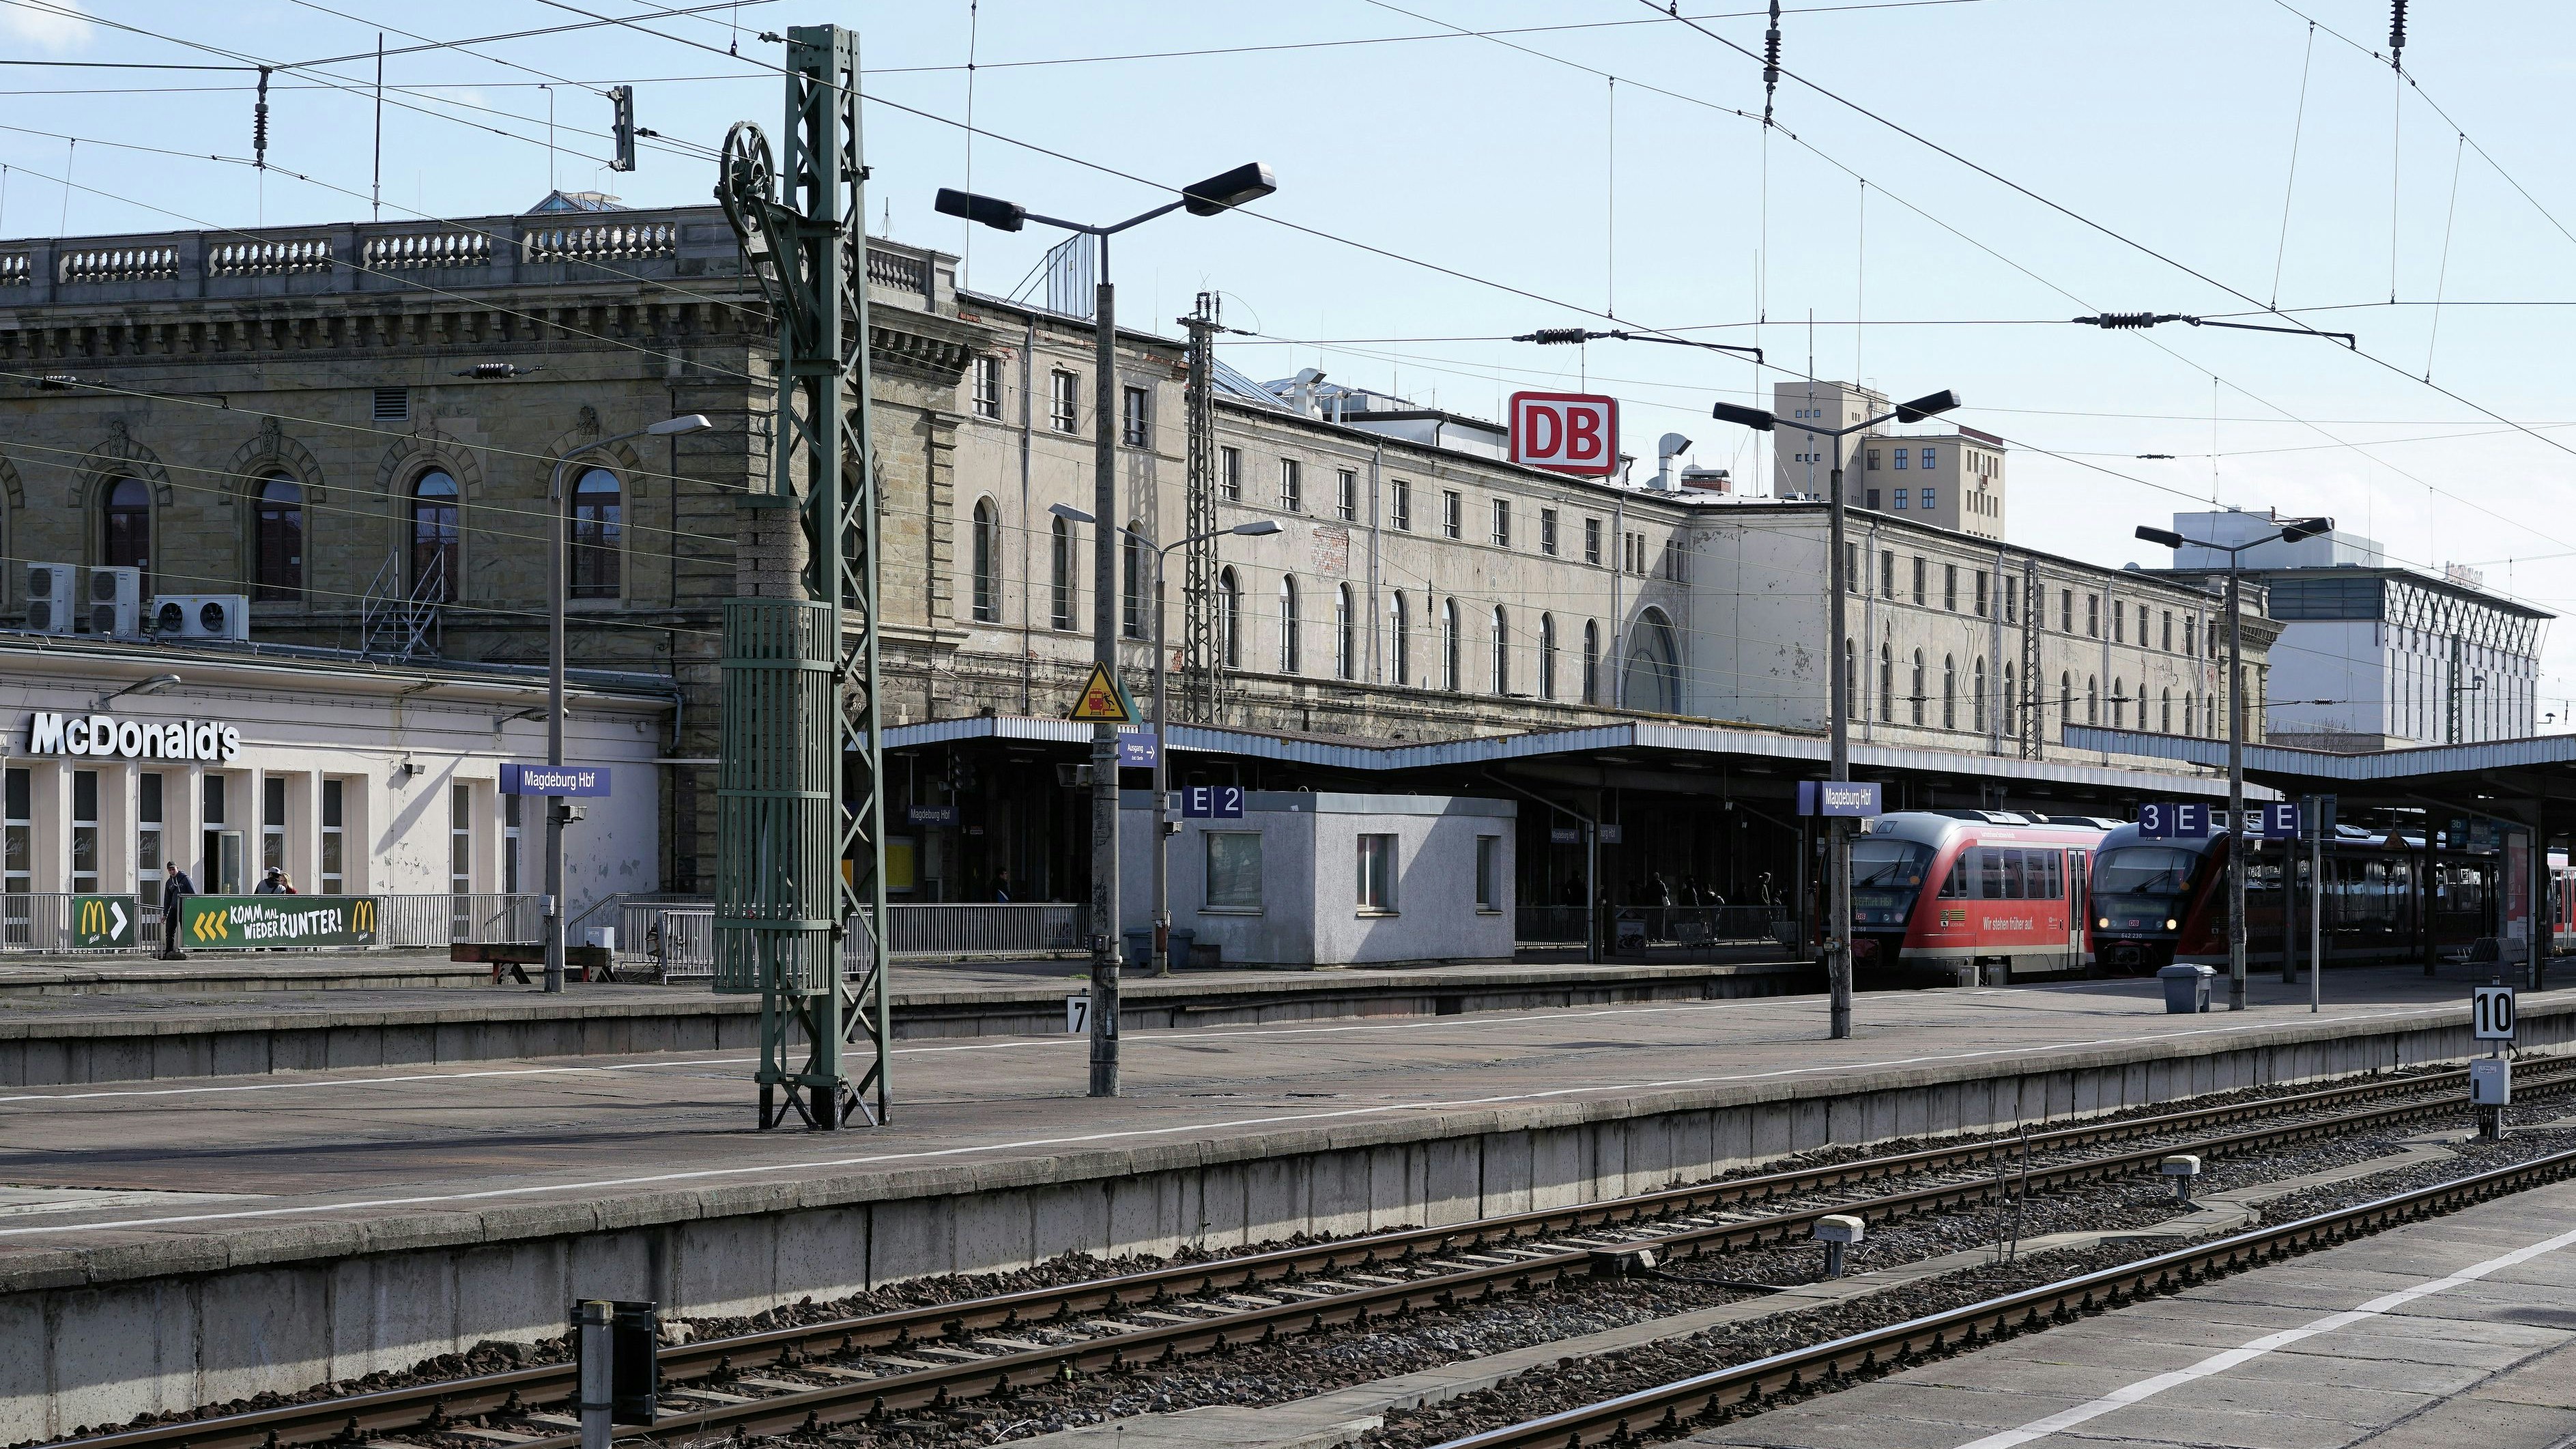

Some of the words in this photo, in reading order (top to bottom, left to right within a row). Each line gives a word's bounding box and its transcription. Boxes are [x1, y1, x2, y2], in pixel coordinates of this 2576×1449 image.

[1526, 405, 1602, 460] DB
[29, 712, 241, 762] McDonald's
[1127, 743, 1144, 754] Ausgang
[524, 771, 577, 791] Magdeburg
[579, 772, 595, 788] Hbf
[1194, 787, 1207, 811] E
[1225, 787, 1239, 811] 2
[1825, 788, 1859, 809] Magdeburg
[1861, 789, 1872, 805] Hbf
[911, 808, 940, 821] Magdeburg
[941, 809, 950, 820] Hbf
[2143, 805, 2159, 830] 3
[2179, 805, 2195, 830] E
[2276, 805, 2293, 829] E
[230, 903, 263, 924] KOMM
[265, 908, 278, 920] MAL
[279, 907, 343, 938] RUNTER!
[1983, 916, 1992, 930] Wir
[1993, 916, 2009, 930] stehen
[2009, 916, 2024, 930] früher
[2024, 916, 2034, 930] auf.
[1074, 1002, 1087, 1033] 7
[2476, 992, 2512, 1032] 10
